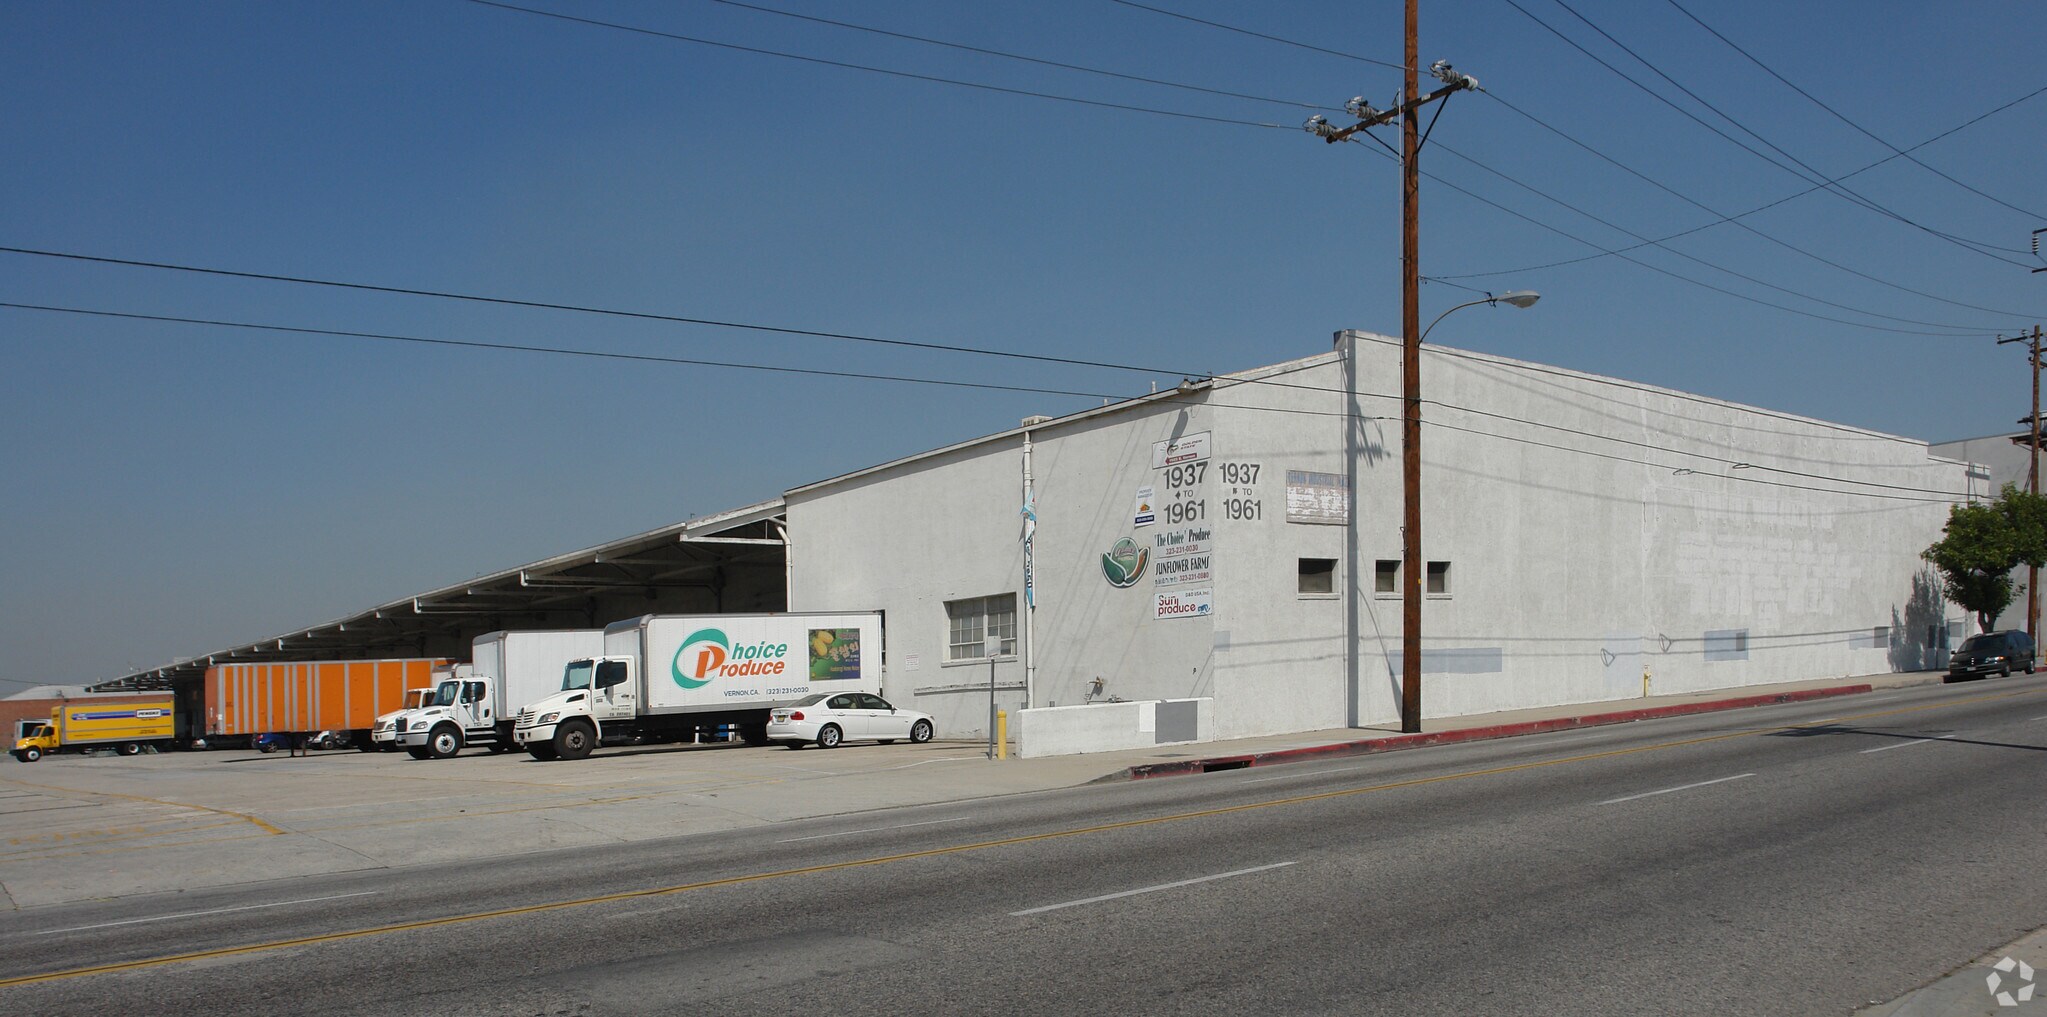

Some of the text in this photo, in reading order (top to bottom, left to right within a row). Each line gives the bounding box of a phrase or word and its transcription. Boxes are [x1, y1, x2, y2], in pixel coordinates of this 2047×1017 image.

[1163, 461, 1208, 489] 1937
[1219, 462, 1261, 485] 1937
[1183, 490, 1194, 498] TO
[1242, 488, 1253, 496] TO
[1163, 499, 1206, 524] 1961
[1223, 498, 1262, 520] 1961
[1166, 545, 1198, 555] 323-231-0030
[1155, 555, 1210, 575] SUNFLOWER FARMS
[1158, 603, 1196, 617] produce
